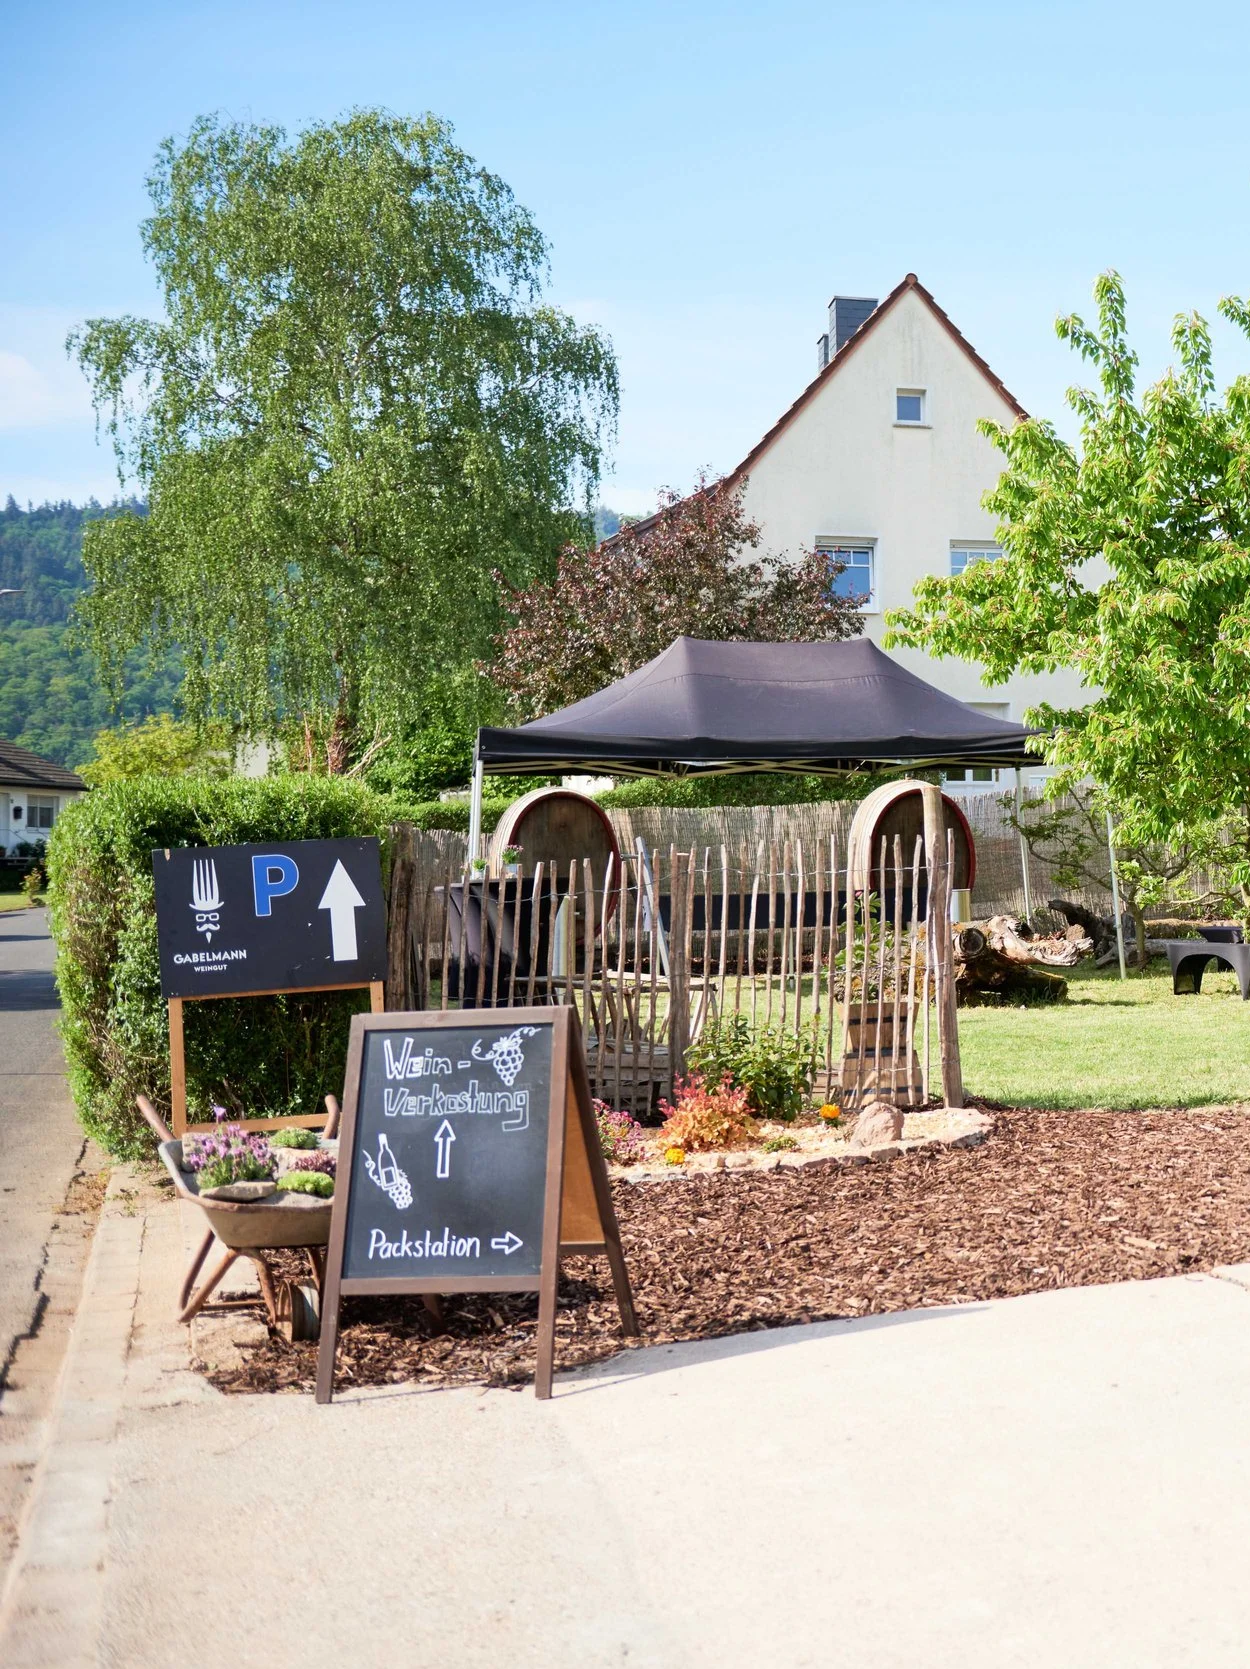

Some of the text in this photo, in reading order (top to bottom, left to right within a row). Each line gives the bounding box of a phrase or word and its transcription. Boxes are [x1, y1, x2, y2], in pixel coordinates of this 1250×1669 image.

[252, 854, 300, 917] P
[173, 949, 247, 964] GABELMANN
[194, 964, 228, 972] WEINGUT
[384, 1080, 529, 1132] Verkostung
[368, 1227, 480, 1259] Packstation
